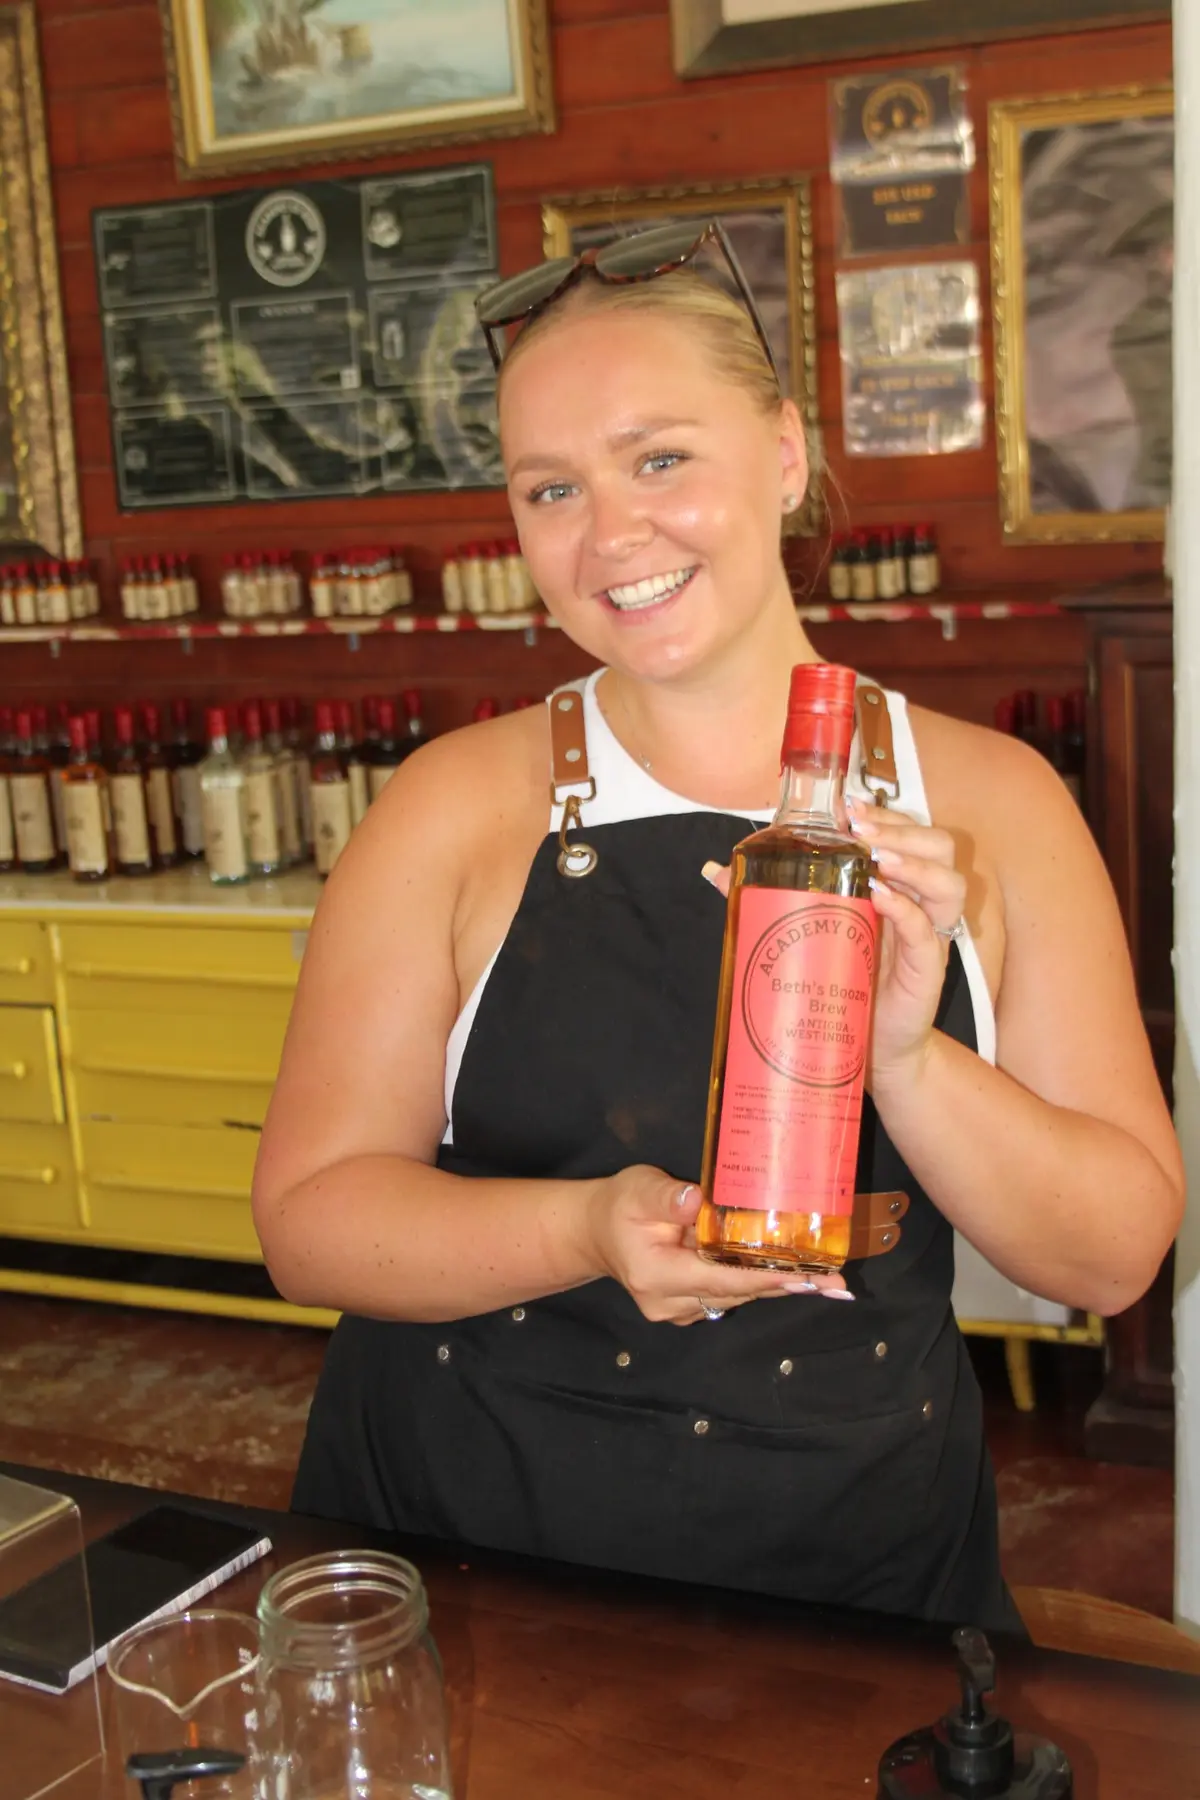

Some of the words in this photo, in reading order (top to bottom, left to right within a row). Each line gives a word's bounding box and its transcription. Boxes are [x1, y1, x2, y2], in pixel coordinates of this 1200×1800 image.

[760, 920, 842, 977] ACADEMY
[847, 926, 865, 945] OF
[771, 978, 825, 996] Beth's
[809, 999, 848, 1016] Brew
[796, 1018, 849, 1034] ANTIGUA
[786, 1029, 820, 1042] WEST
[822, 1031, 857, 1045] INDIES
